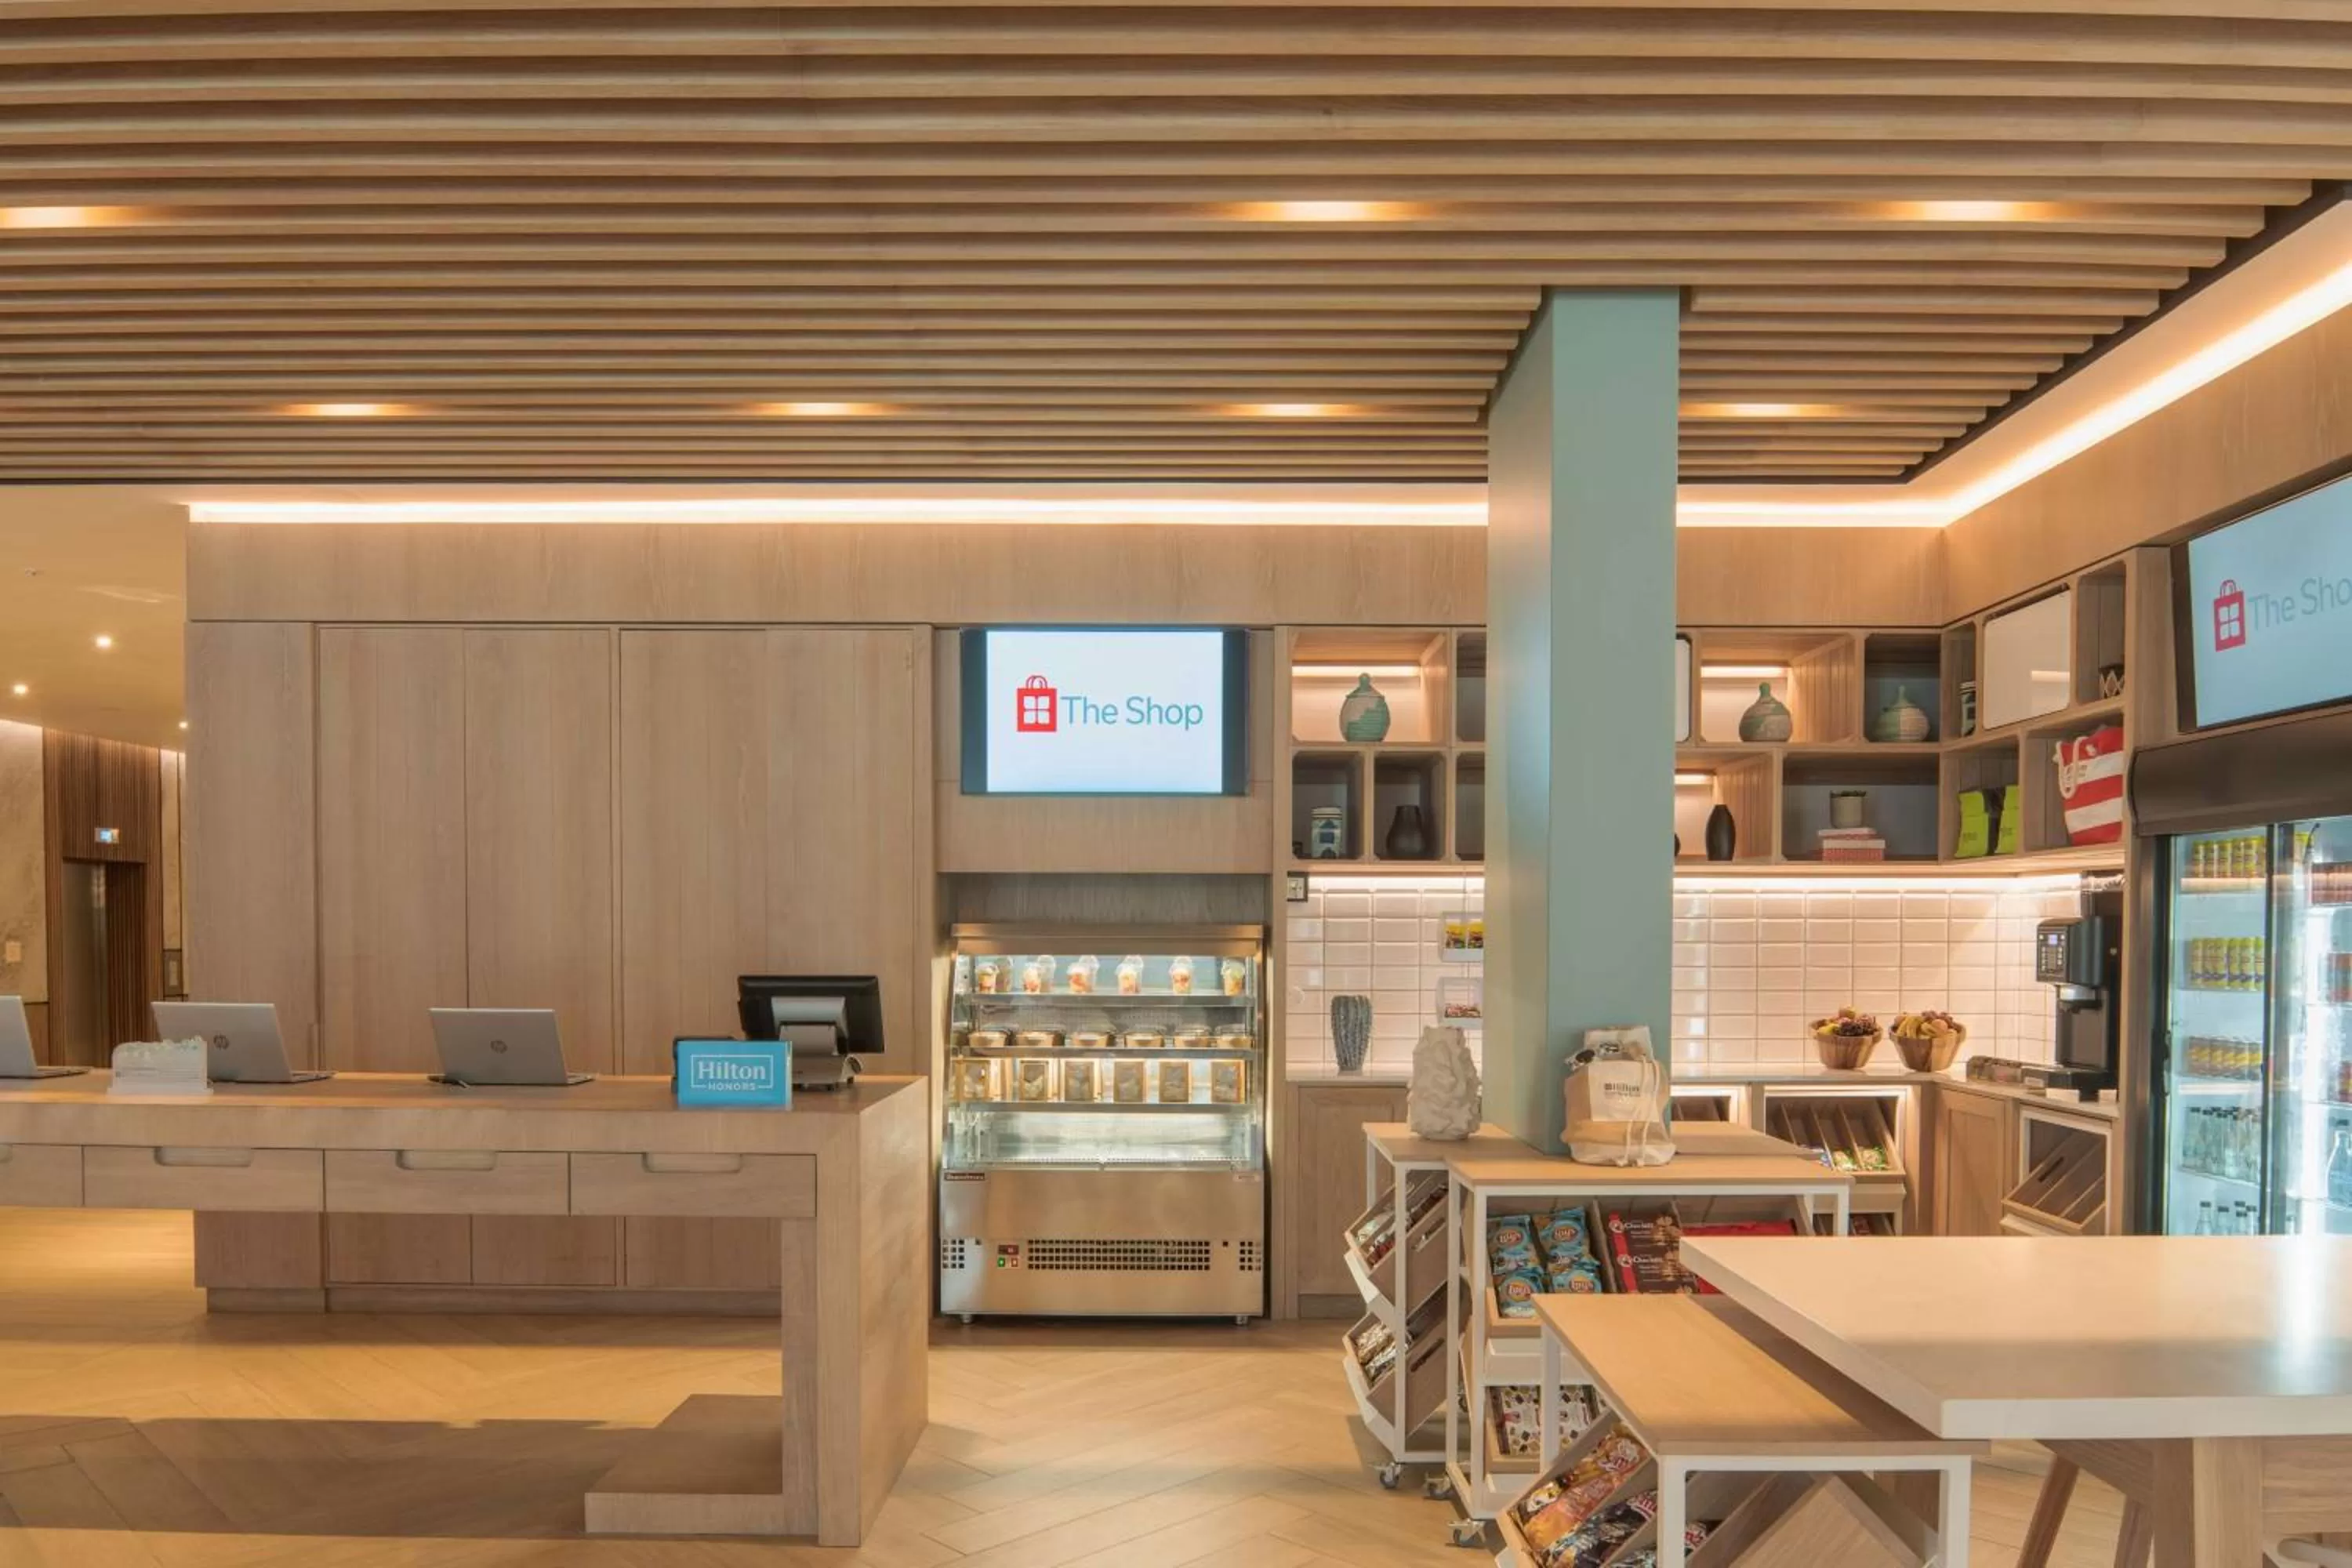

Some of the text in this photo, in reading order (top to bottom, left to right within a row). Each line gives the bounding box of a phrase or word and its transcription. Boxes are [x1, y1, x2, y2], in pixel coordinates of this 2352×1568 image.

[2248, 592, 2296, 631] The
[1061, 695, 1203, 731] The Shop
[698, 1061, 766, 1080] Hilton
[708, 1082, 756, 1091] HONORS
